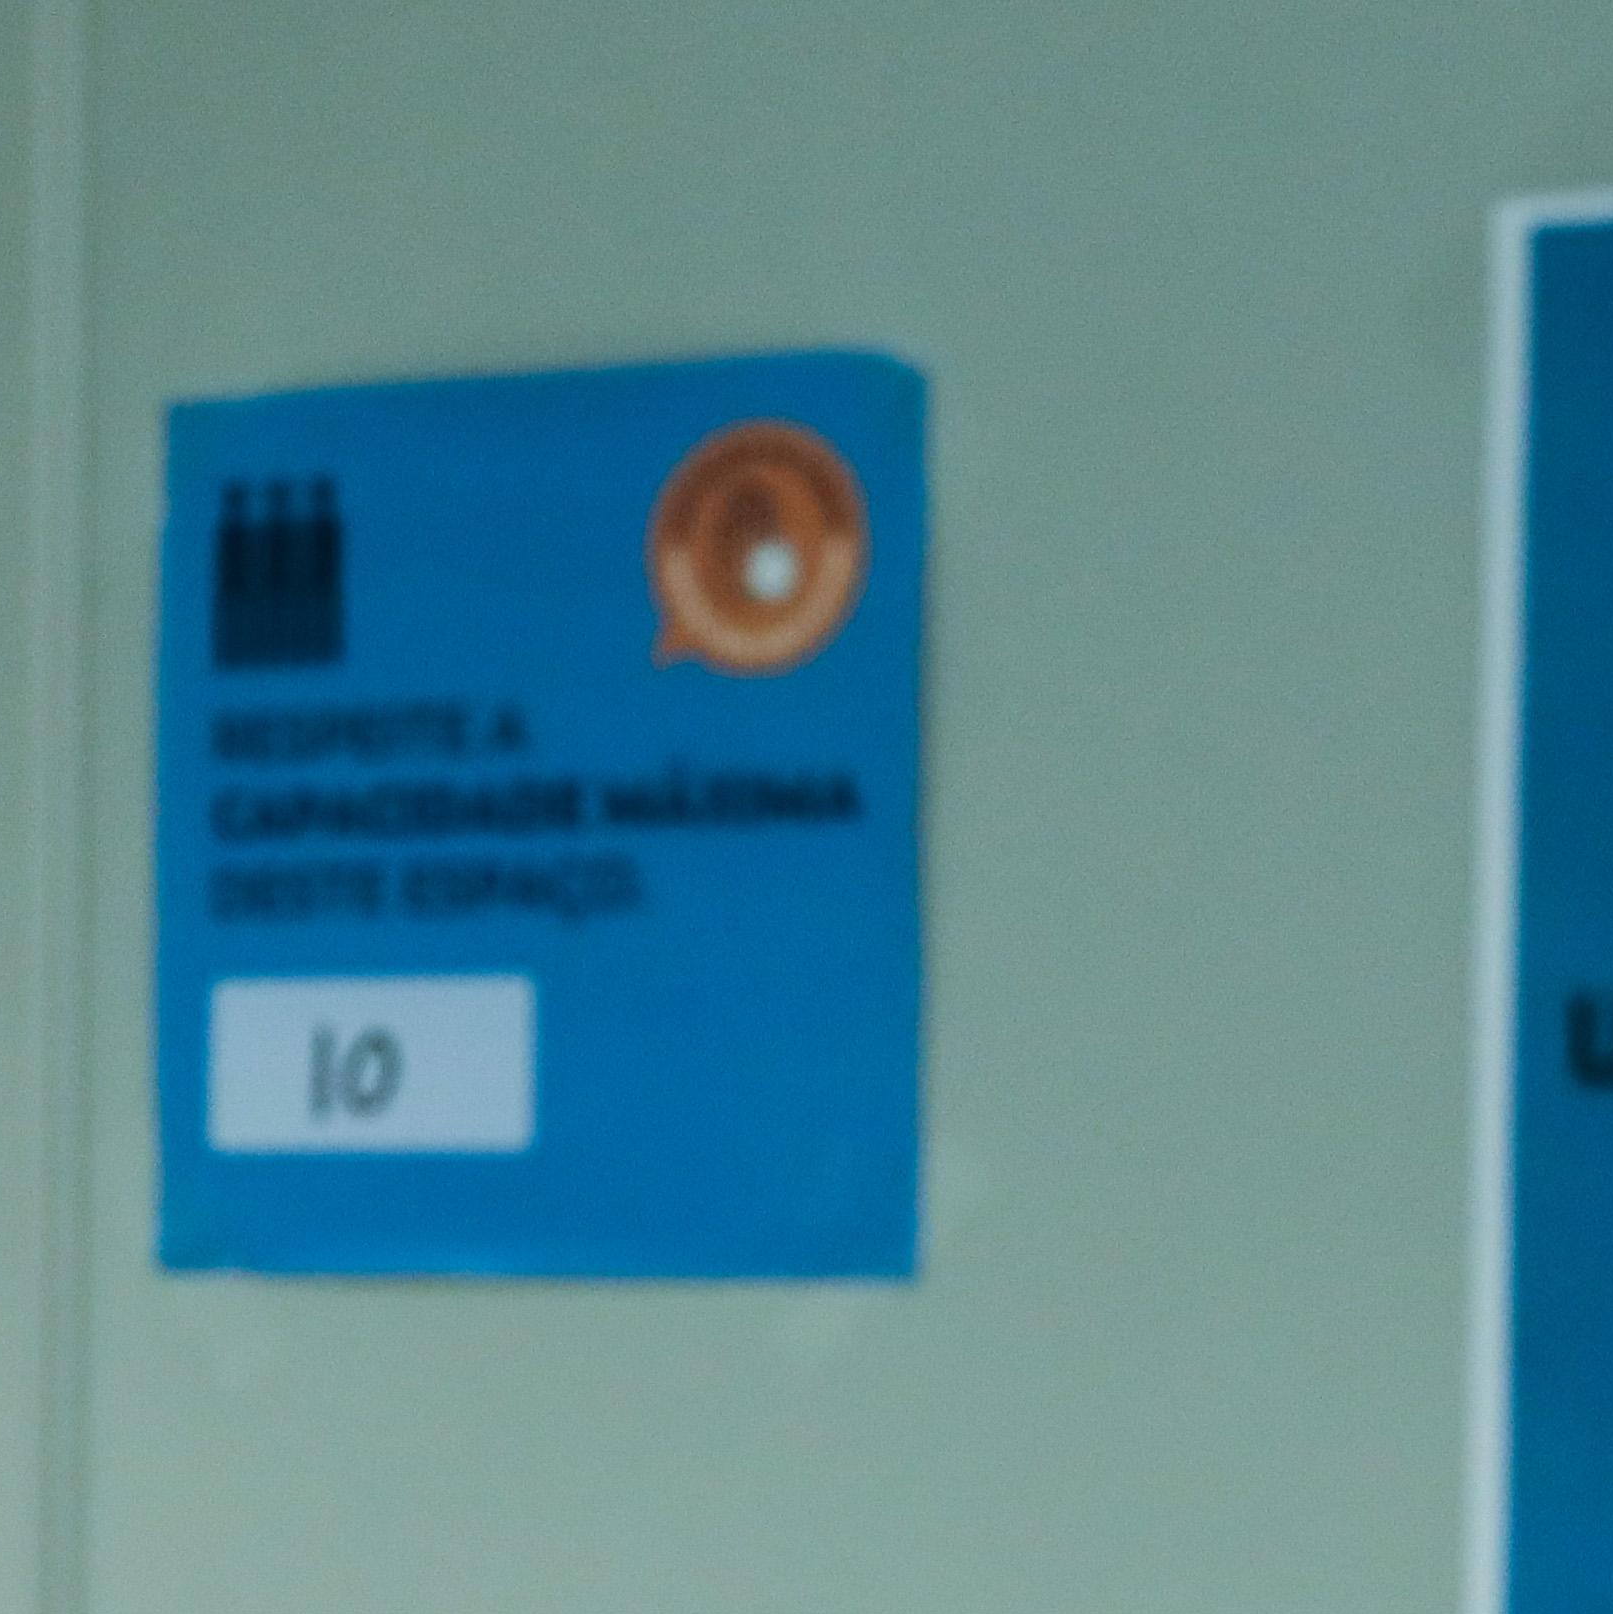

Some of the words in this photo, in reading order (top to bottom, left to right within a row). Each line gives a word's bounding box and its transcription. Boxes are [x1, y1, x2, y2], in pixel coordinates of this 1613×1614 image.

[488, 703, 527, 756] A
[210, 772, 587, 842] CAPACIDADE
[599, 756, 863, 828] MÁXIMA
[308, 1019, 405, 1122] 10
